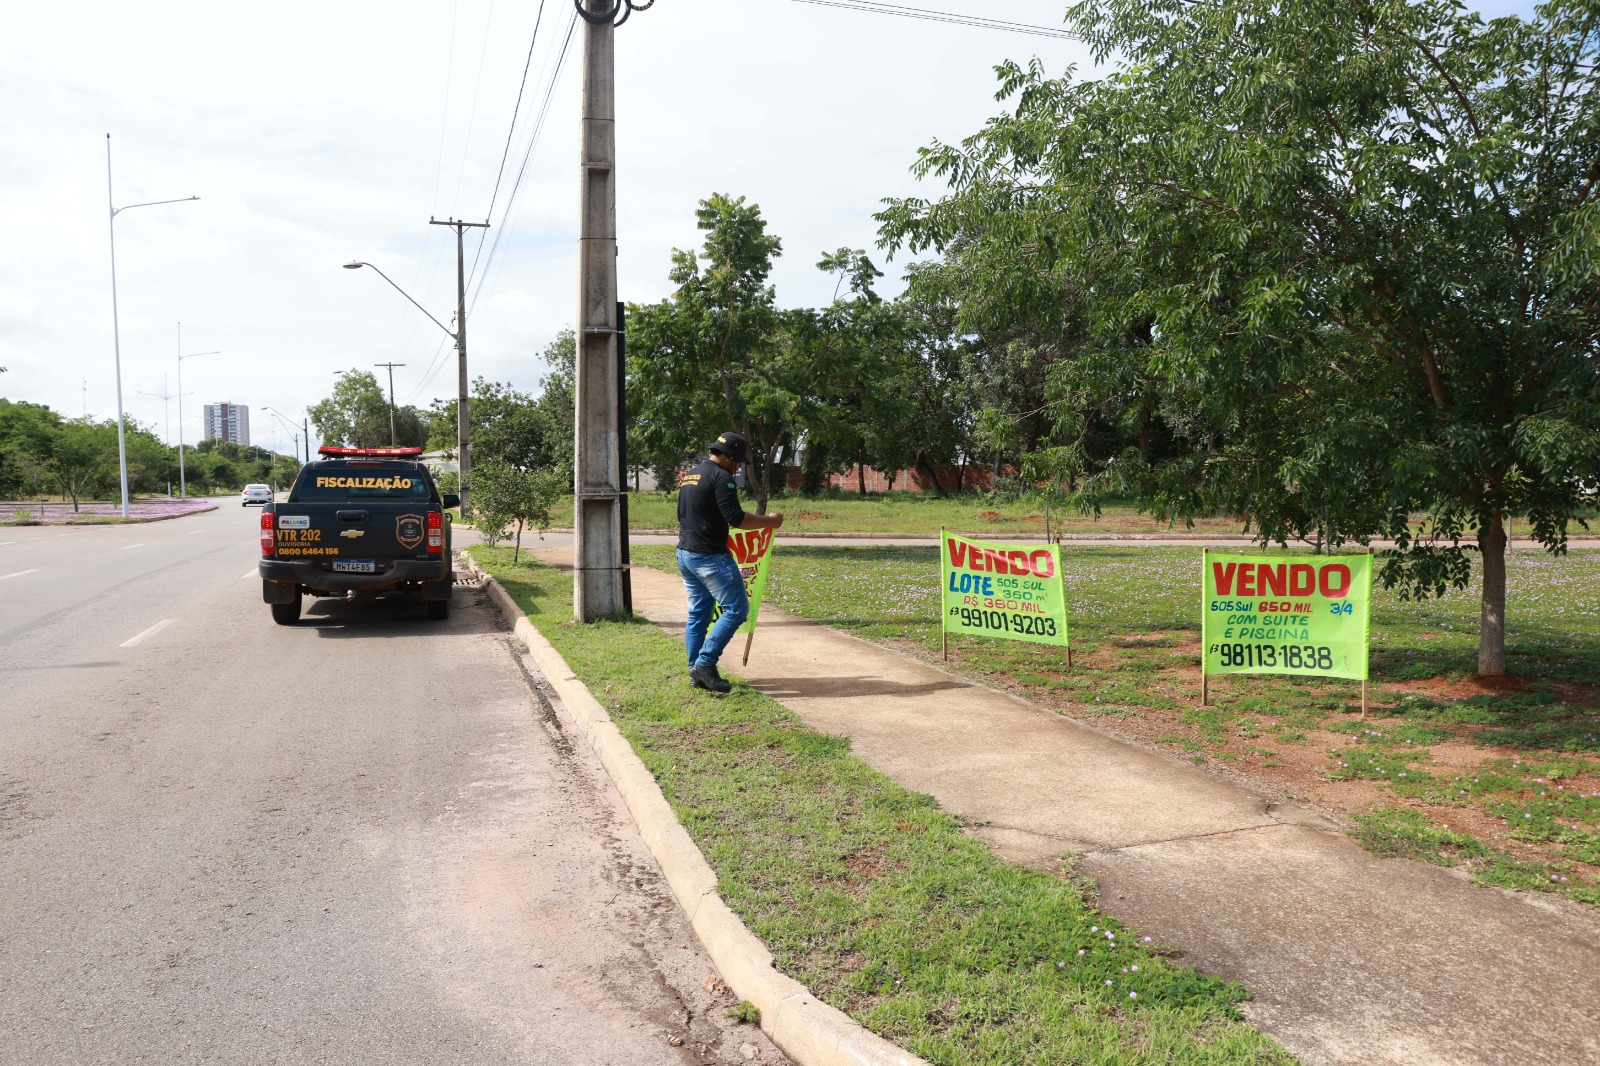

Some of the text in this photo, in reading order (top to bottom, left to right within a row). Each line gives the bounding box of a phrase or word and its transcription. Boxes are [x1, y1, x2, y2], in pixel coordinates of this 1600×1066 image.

[316, 476, 412, 490] FISCALIZAÇÃO
[276, 529, 321, 541] VTR 202
[278, 547, 339, 555] 0800 6464 156
[726, 526, 773, 564] NDO
[947, 538, 1055, 578] VENDO
[949, 571, 1046, 596] LOTE 505 SUL
[1213, 562, 1351, 599] VENDO
[1002, 589, 1033, 601] 360
[963, 595, 979, 608] R$
[1021, 602, 1046, 614] MIL
[1211, 600, 1235, 612] 505
[1258, 601, 1292, 613] 650
[1293, 602, 1314, 613] MIL
[1330, 600, 1353, 616] 3/4
[1227, 614, 1309, 626] COM SUITE
[1224, 628, 1310, 641] E PISCINA
